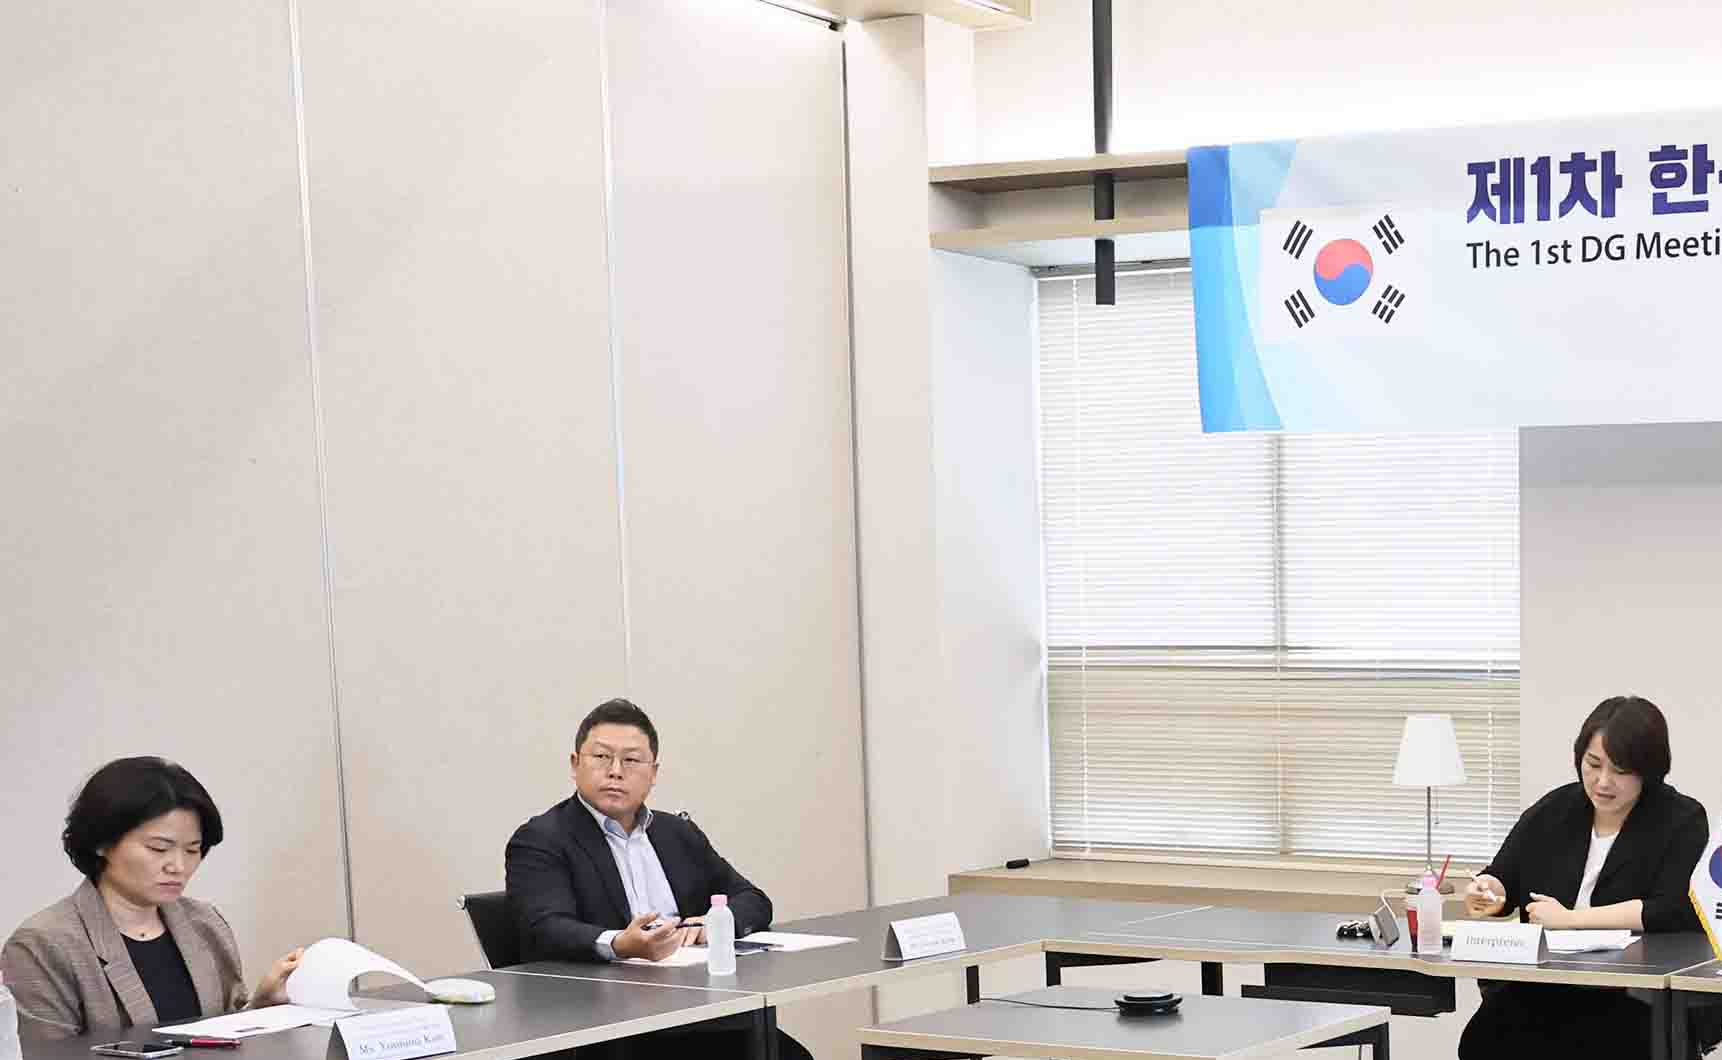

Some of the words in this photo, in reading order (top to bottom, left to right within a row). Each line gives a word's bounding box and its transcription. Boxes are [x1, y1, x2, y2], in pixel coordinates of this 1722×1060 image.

[1466, 150, 1622, 224] 제1차
[1465, 240, 1519, 268] The
[1530, 239, 1572, 264] 1st
[1581, 233, 1625, 262] DG
